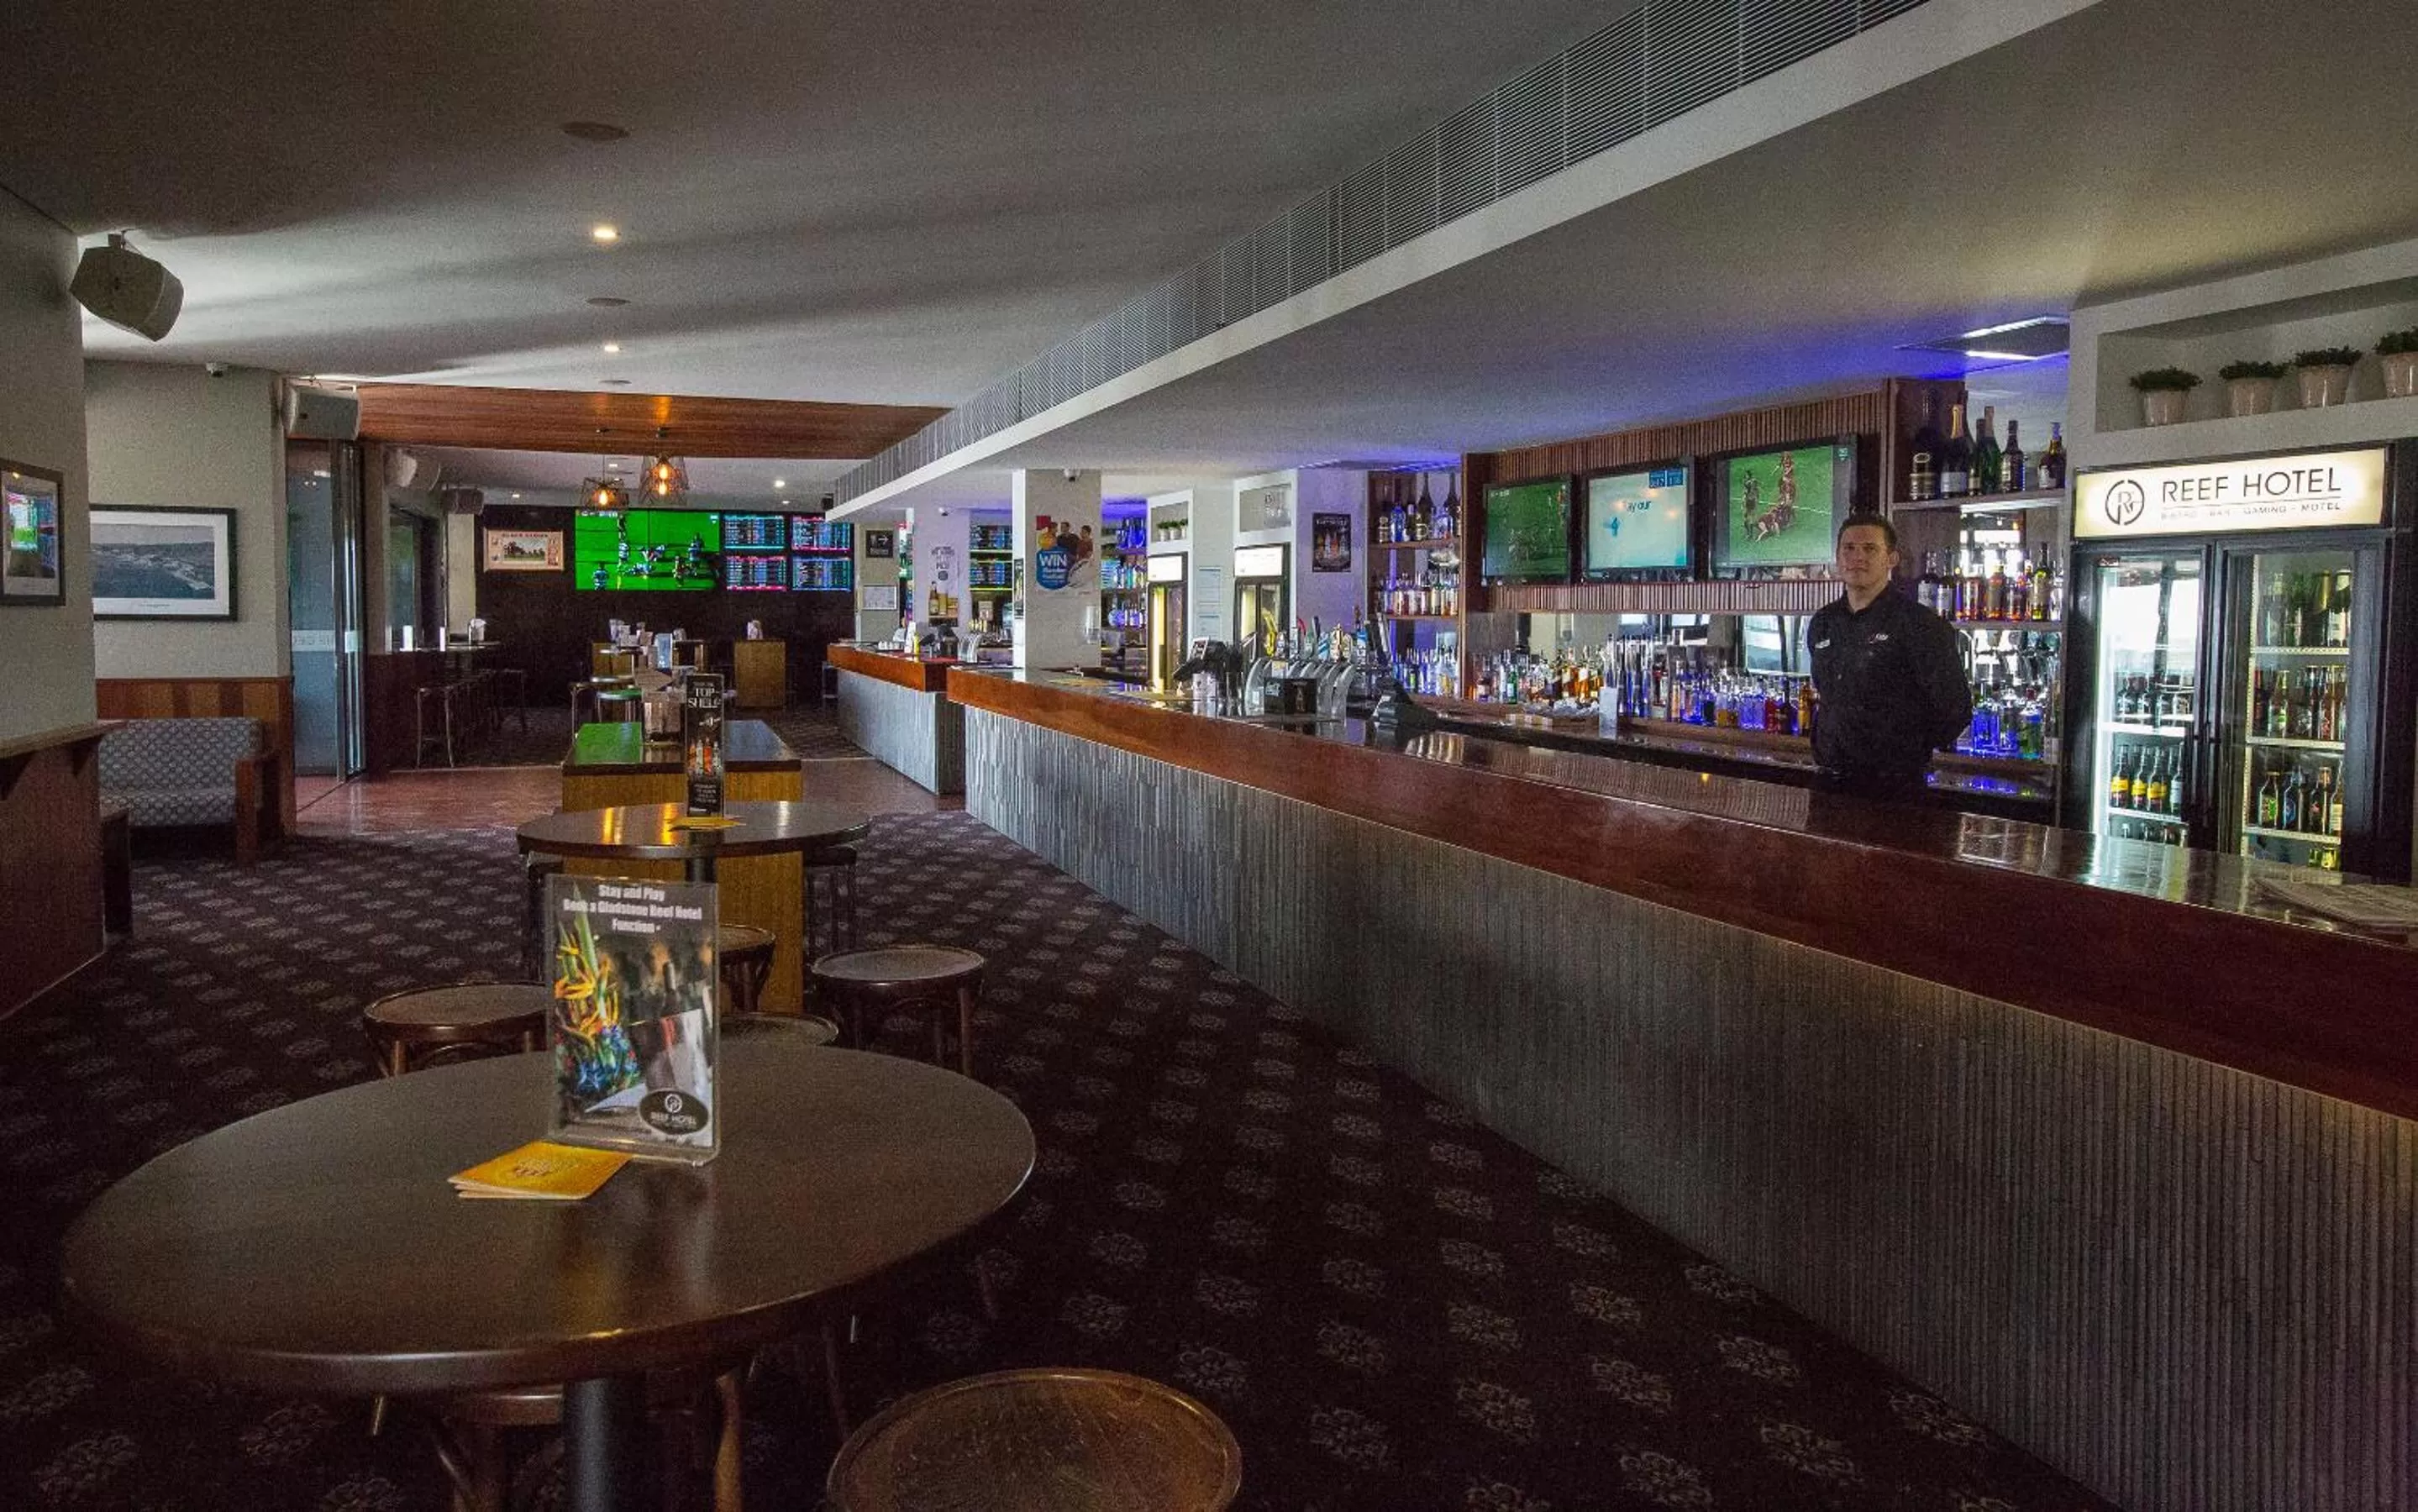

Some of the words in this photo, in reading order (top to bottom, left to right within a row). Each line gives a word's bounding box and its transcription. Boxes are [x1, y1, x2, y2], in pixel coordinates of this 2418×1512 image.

[2162, 476, 2229, 503] REEF
[2243, 467, 2342, 497] HOTEL
[2243, 505, 2287, 515] GAMING
[2300, 501, 2341, 512] MOTEL
[1038, 554, 1067, 567] WIN
[598, 885, 622, 899] Stay
[623, 886, 642, 899] and
[644, 887, 665, 901] Play
[649, 904, 674, 918] Reef
[675, 906, 702, 921] Hotel
